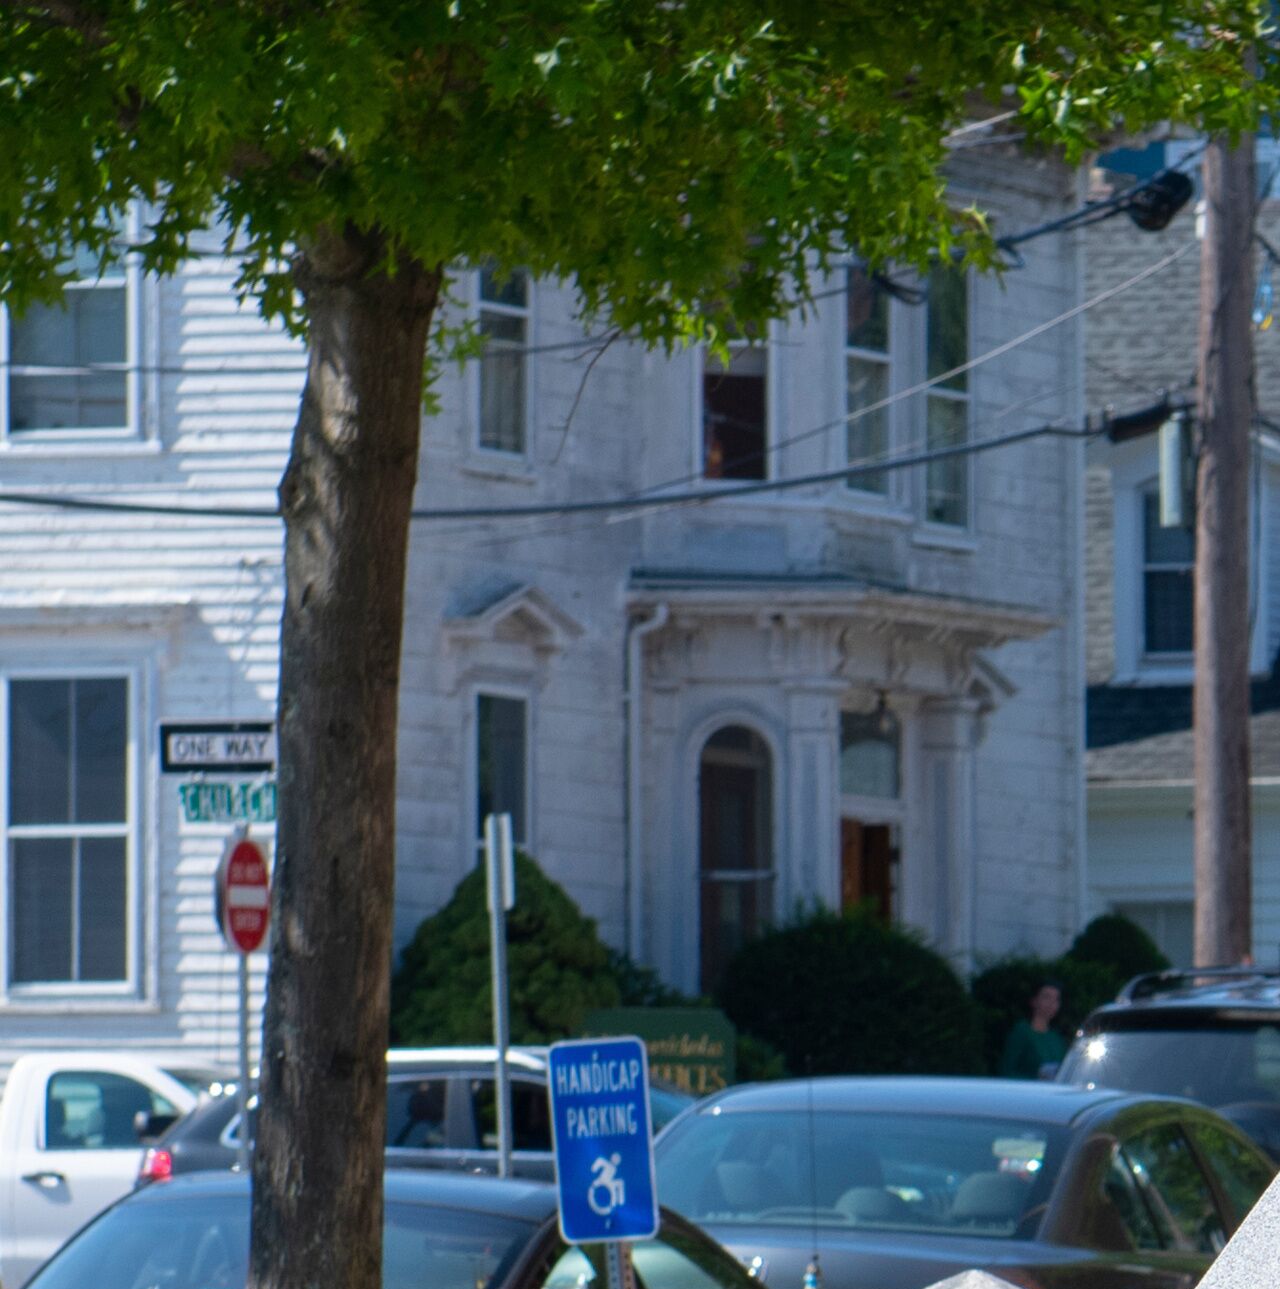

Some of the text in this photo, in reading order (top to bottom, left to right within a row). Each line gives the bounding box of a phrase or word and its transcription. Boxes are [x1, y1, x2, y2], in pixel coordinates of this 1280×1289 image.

[174, 736, 268, 758] ONE WAY
[557, 1059, 640, 1096] HANDICAP
[566, 1102, 637, 1139] PARKING
